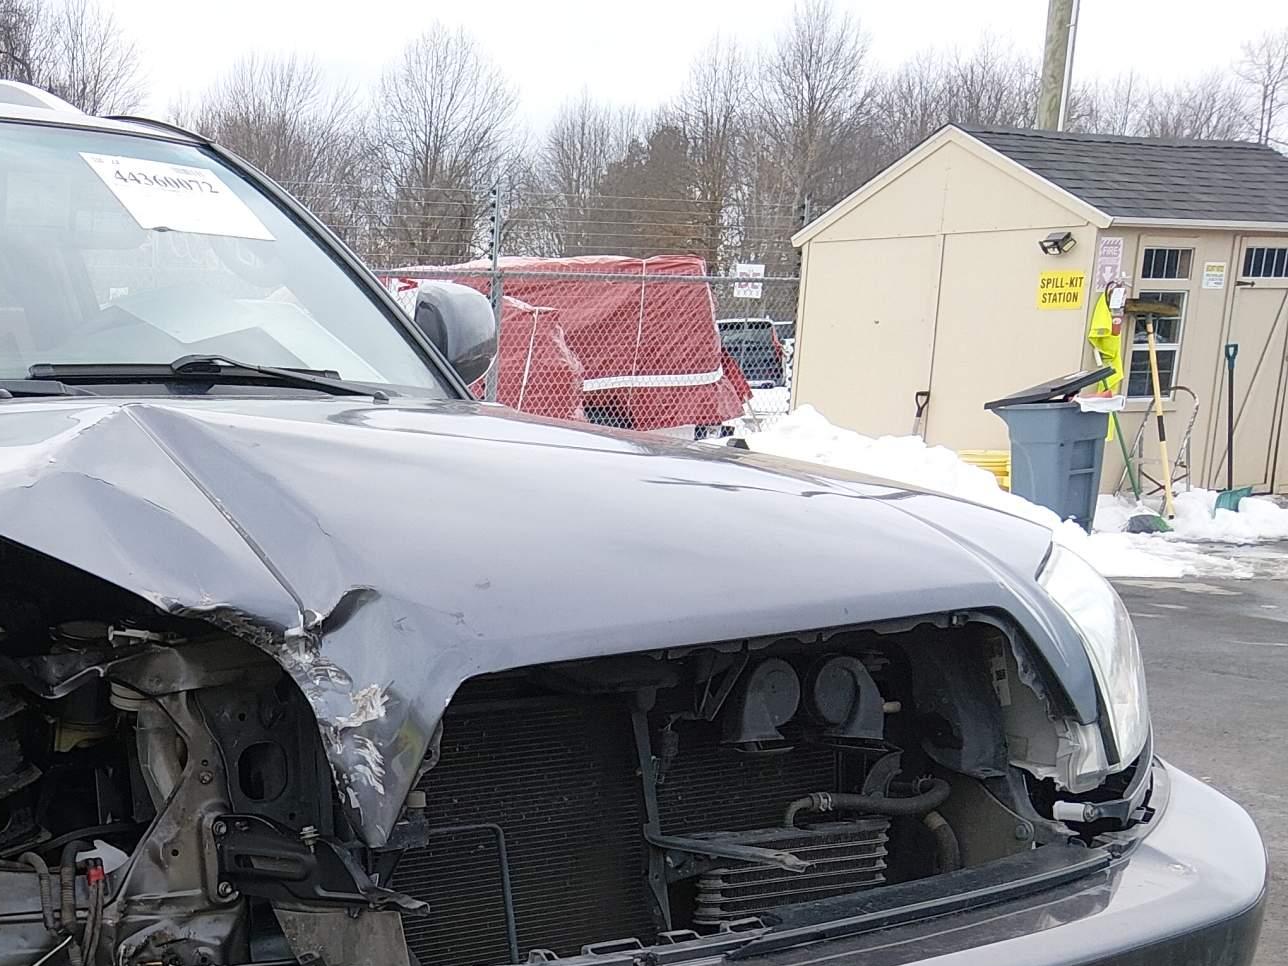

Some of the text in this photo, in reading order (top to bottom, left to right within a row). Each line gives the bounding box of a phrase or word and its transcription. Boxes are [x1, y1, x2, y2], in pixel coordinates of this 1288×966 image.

[114, 169, 219, 194] 44360072
[1040, 276, 1084, 289] SPILL-KIT
[1041, 292, 1079, 304] STATION
